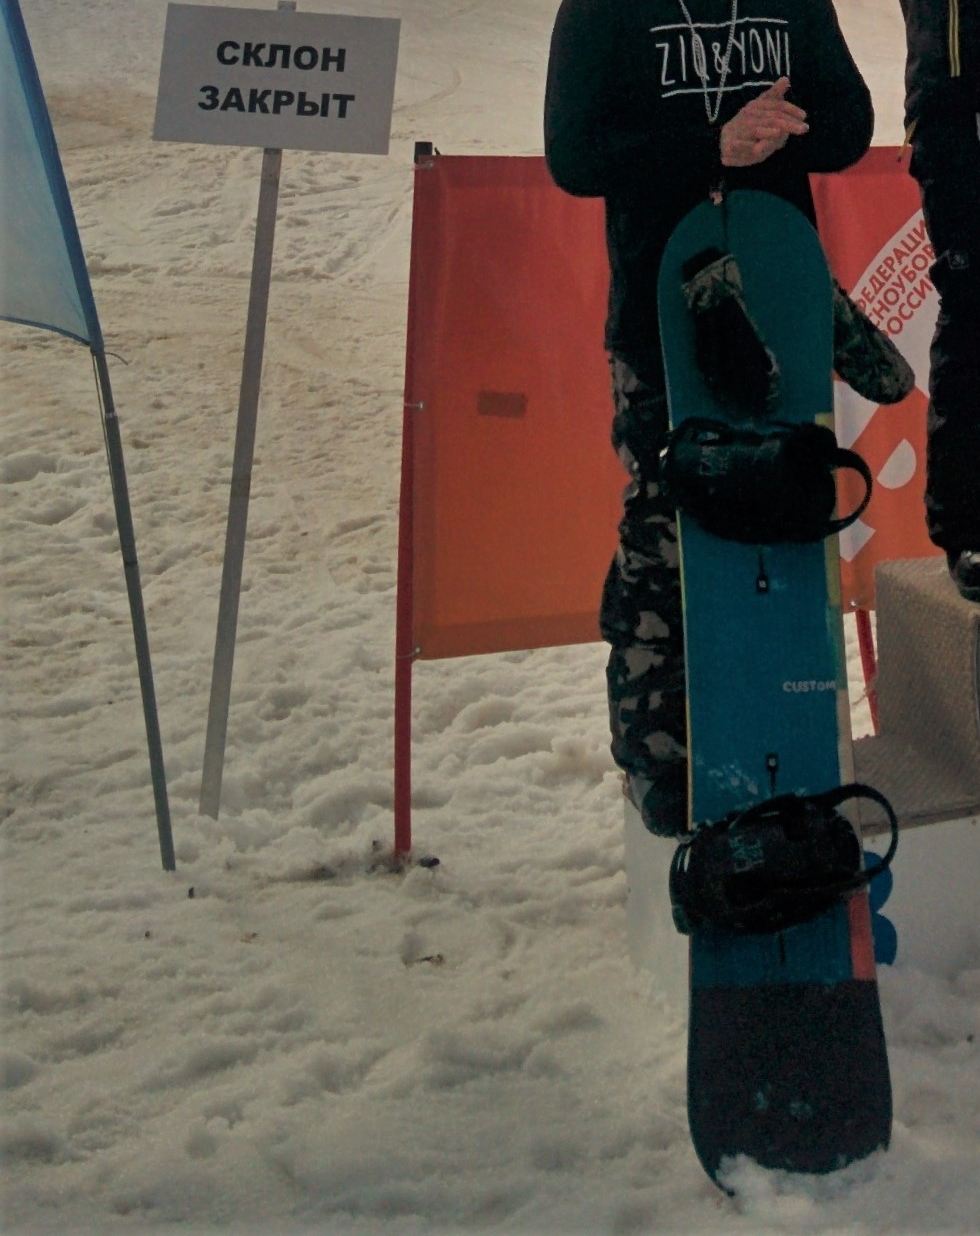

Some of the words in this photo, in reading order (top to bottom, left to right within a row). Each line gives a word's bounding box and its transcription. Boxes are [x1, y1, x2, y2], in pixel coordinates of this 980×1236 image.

[217, 41, 346, 72] СКЛОН
[730, 28, 790, 78] YONI
[198, 85, 355, 118] ЗАКРЫТ
[883, 274, 933, 336] ОССИ
[782, 680, 837, 693] CUSTOM
